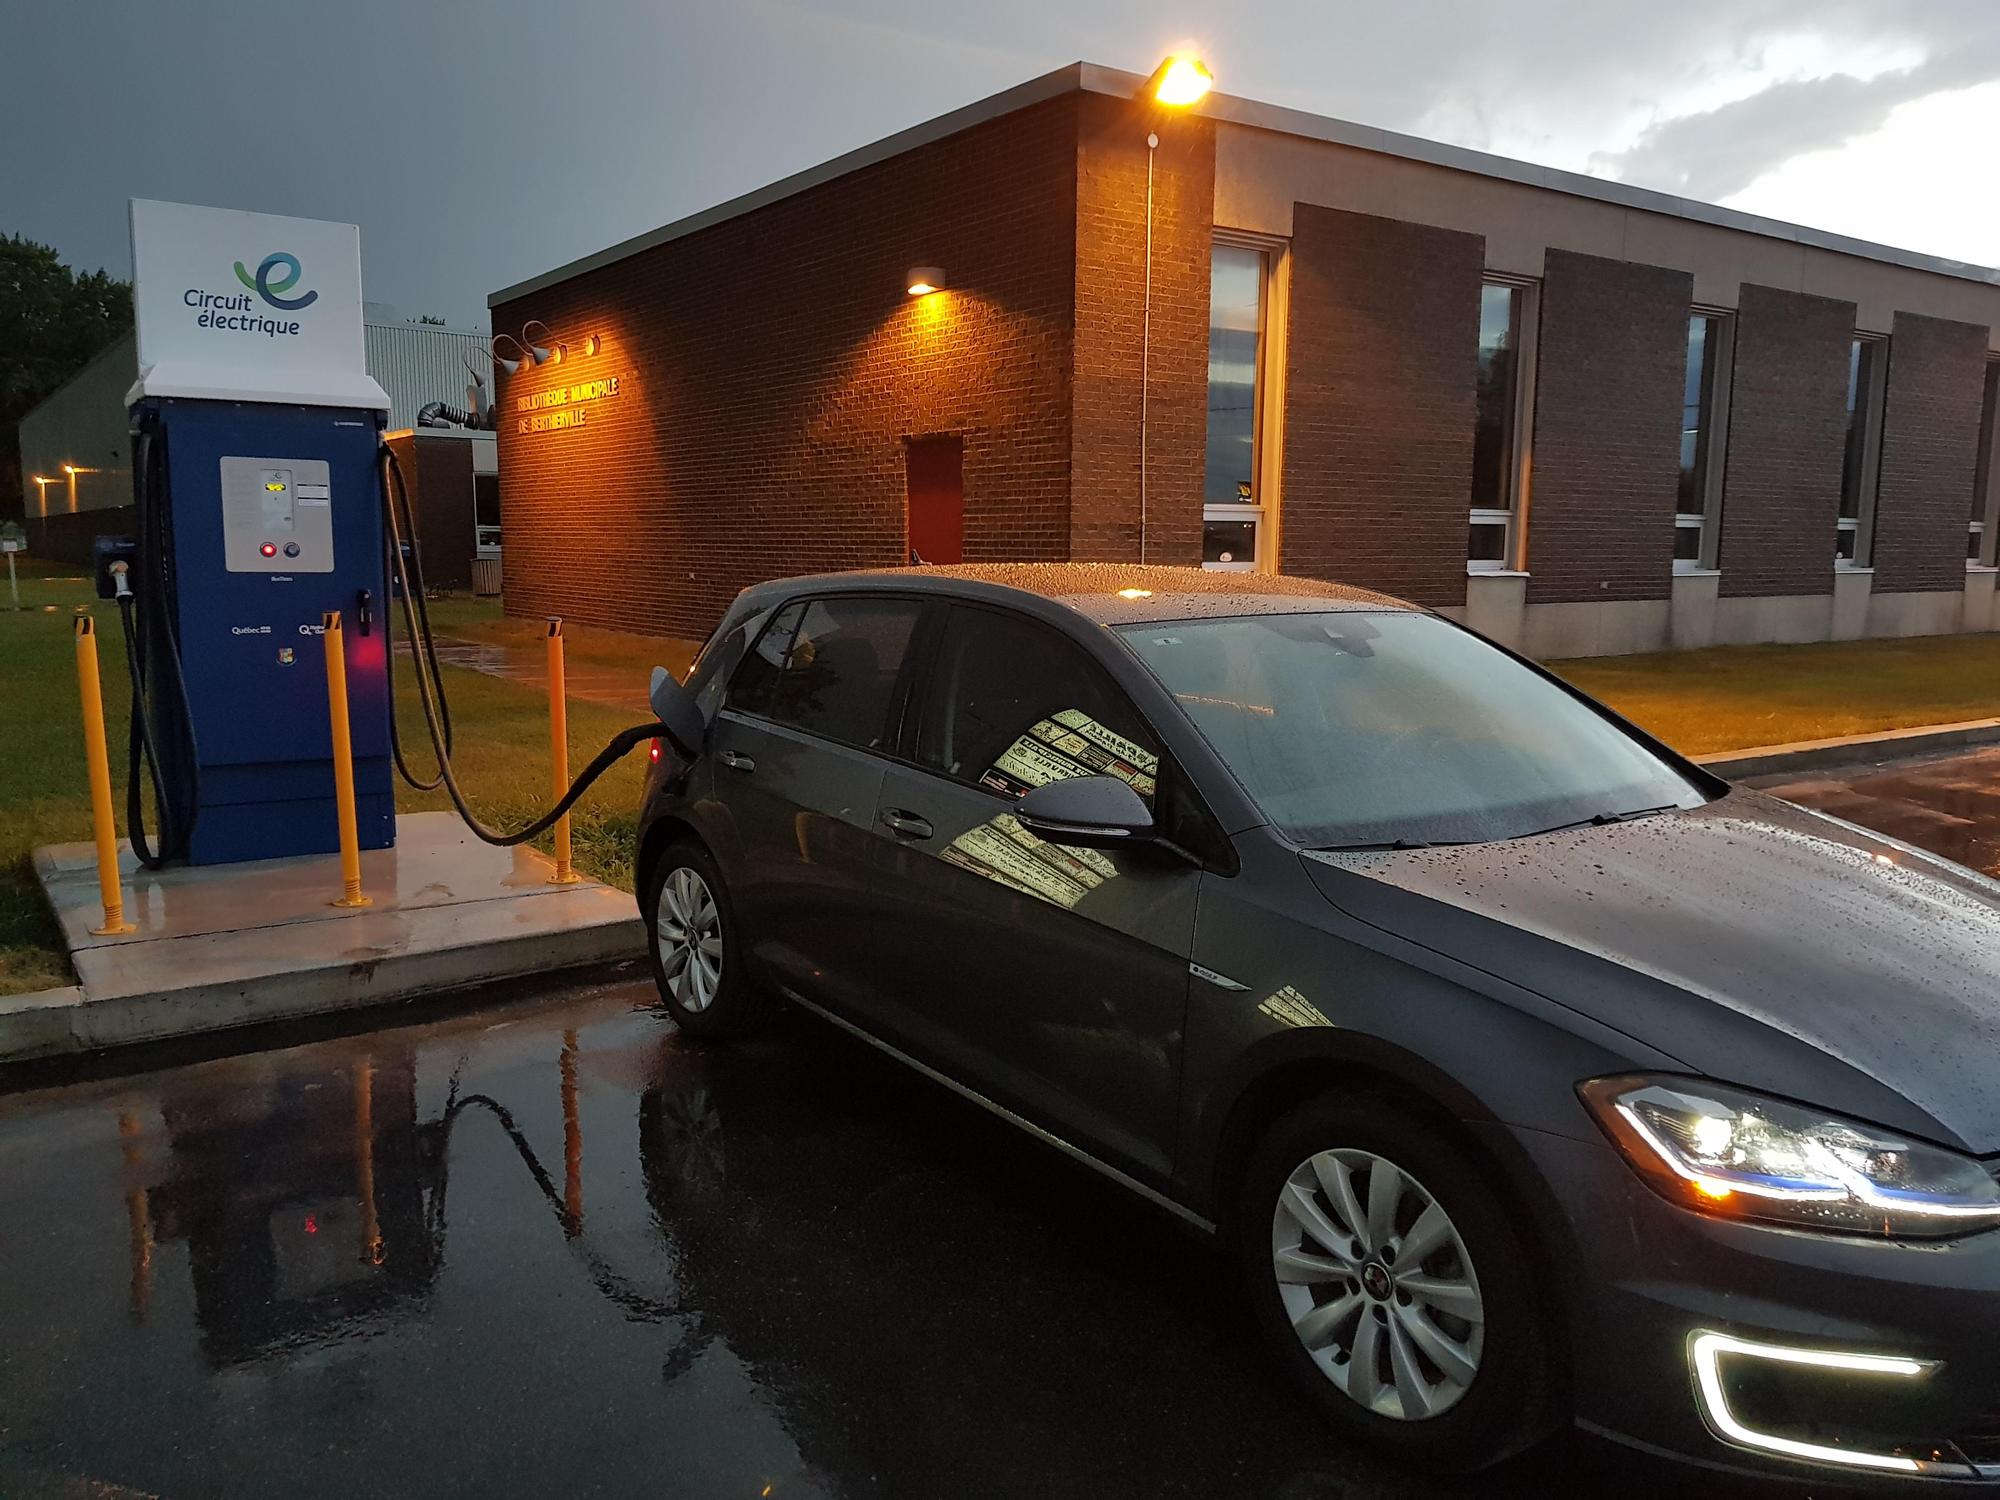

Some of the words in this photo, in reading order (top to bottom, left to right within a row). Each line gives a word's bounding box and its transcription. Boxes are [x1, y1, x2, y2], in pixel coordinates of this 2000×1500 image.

[183, 289, 253, 312] Circuit
[197, 310, 300, 338] électrique
[571, 377, 618, 403] MUNICIPALE
[231, 625, 260, 636] Québec
